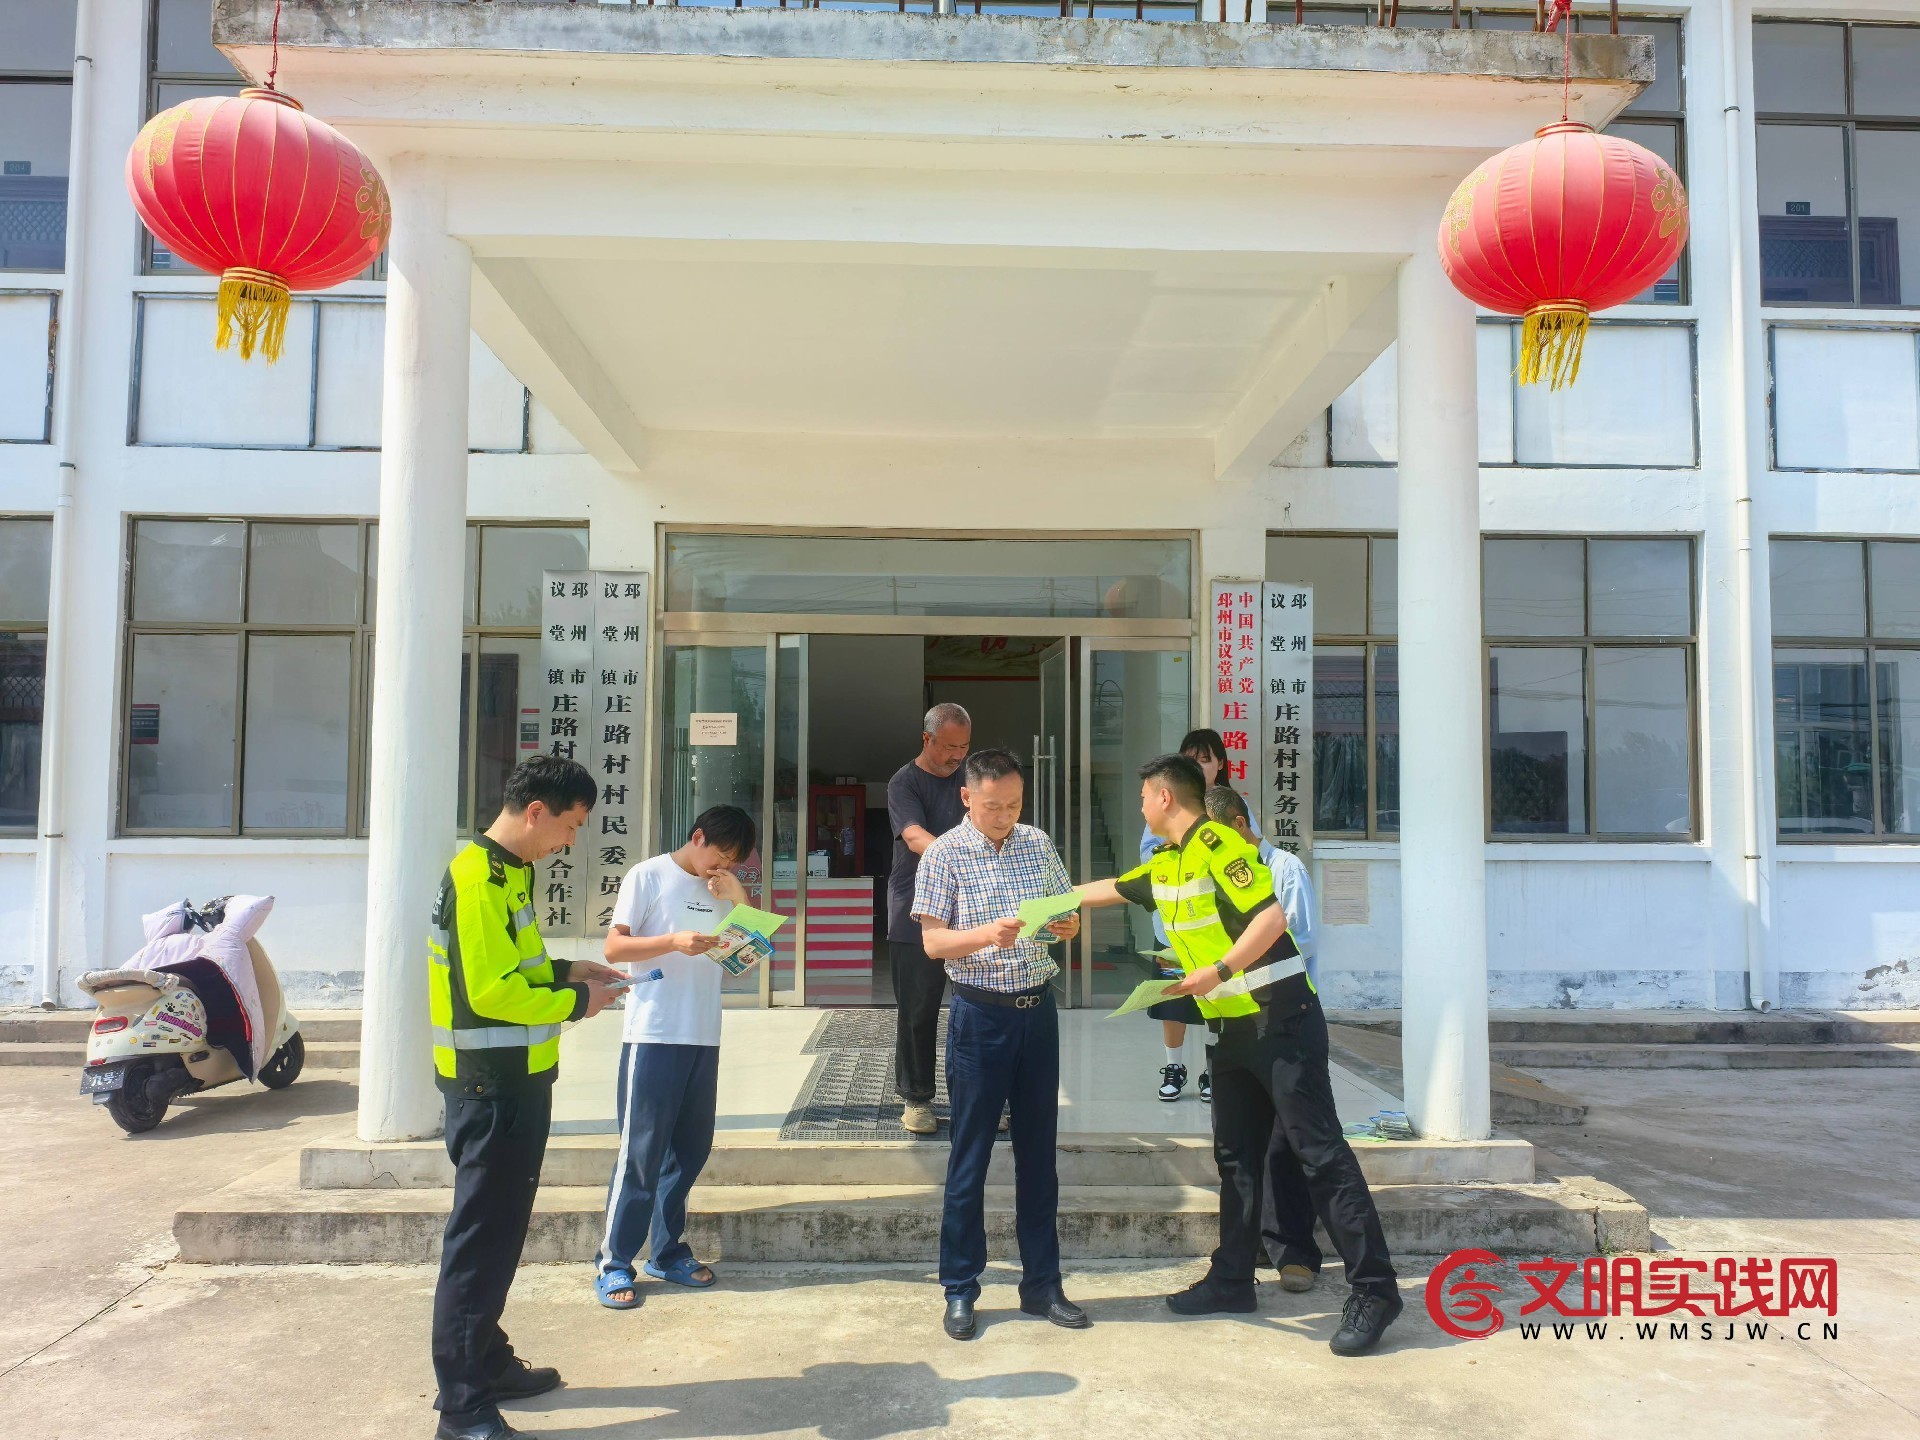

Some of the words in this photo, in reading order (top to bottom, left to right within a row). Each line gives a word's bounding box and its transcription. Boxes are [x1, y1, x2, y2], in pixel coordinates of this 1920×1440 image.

[547, 581, 566, 685] 议堂镇
[571, 582, 589, 685] 邳州市
[601, 583, 619, 686] 议堂镇
[623, 583, 641, 686] 邳州市
[1217, 592, 1233, 694] 邳州市议堂镇
[1238, 591, 1254, 694] 中国共产党
[1270, 593, 1286, 695] 议堂镇
[1291, 593, 1307, 695] 邳州市
[1222, 701, 1249, 796] 庄路村
